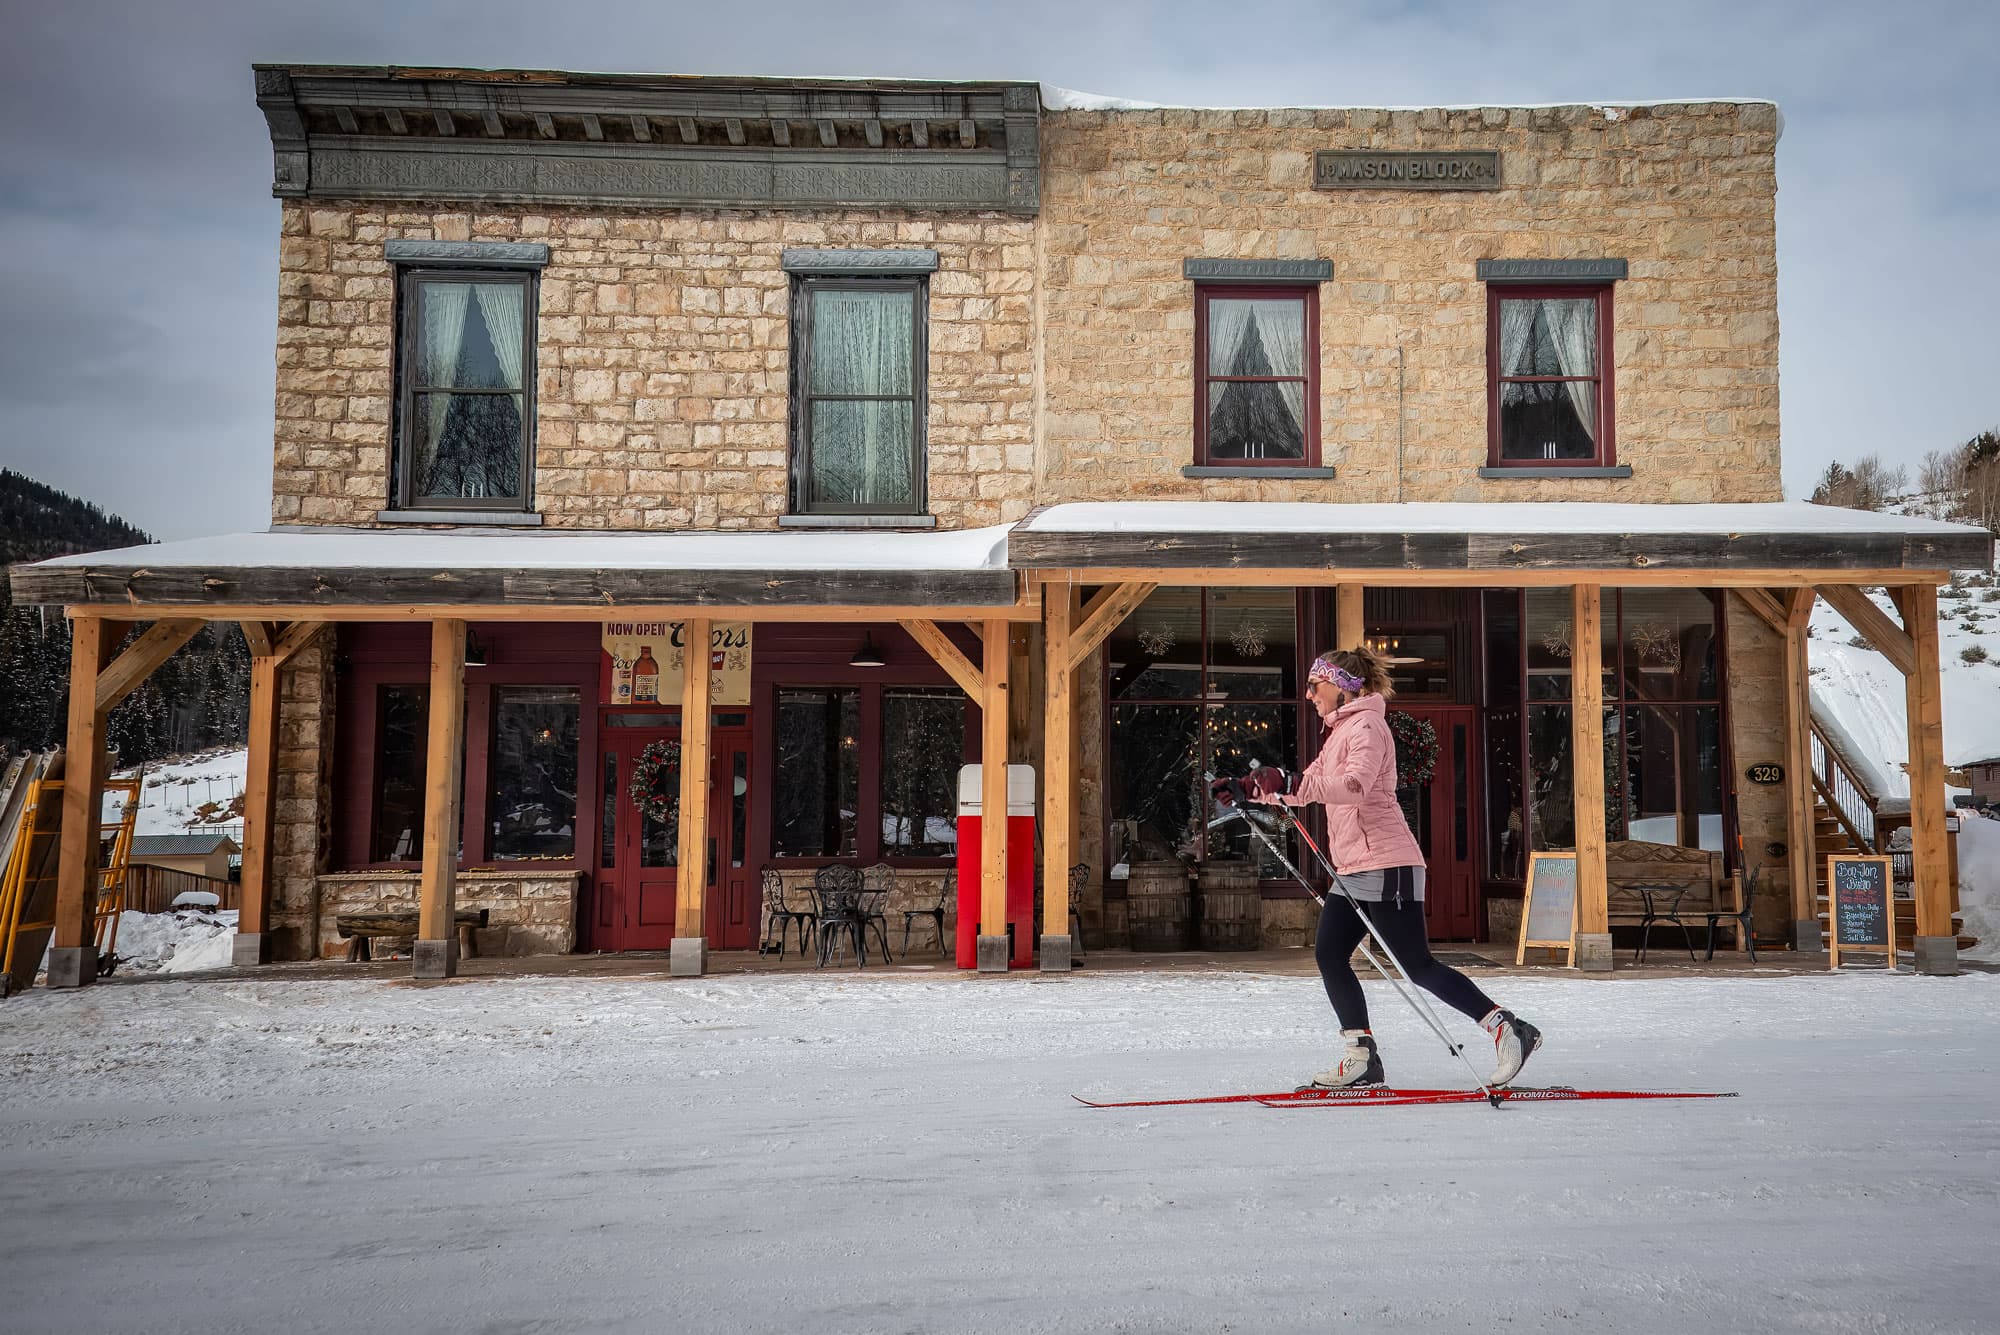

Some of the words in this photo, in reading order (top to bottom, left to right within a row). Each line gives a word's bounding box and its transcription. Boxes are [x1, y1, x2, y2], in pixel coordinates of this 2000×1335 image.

[1338, 159, 1405, 179] MASON
[1408, 159, 1474, 179] BLOCK
[607, 623, 633, 636] NOW
[636, 623, 666, 636] OPEN
[670, 622, 748, 649] Cors
[1754, 767, 1779, 781] 329
[1327, 1090, 1371, 1098] ATOMIC
[1508, 1091, 1554, 1099] ATOMIC
